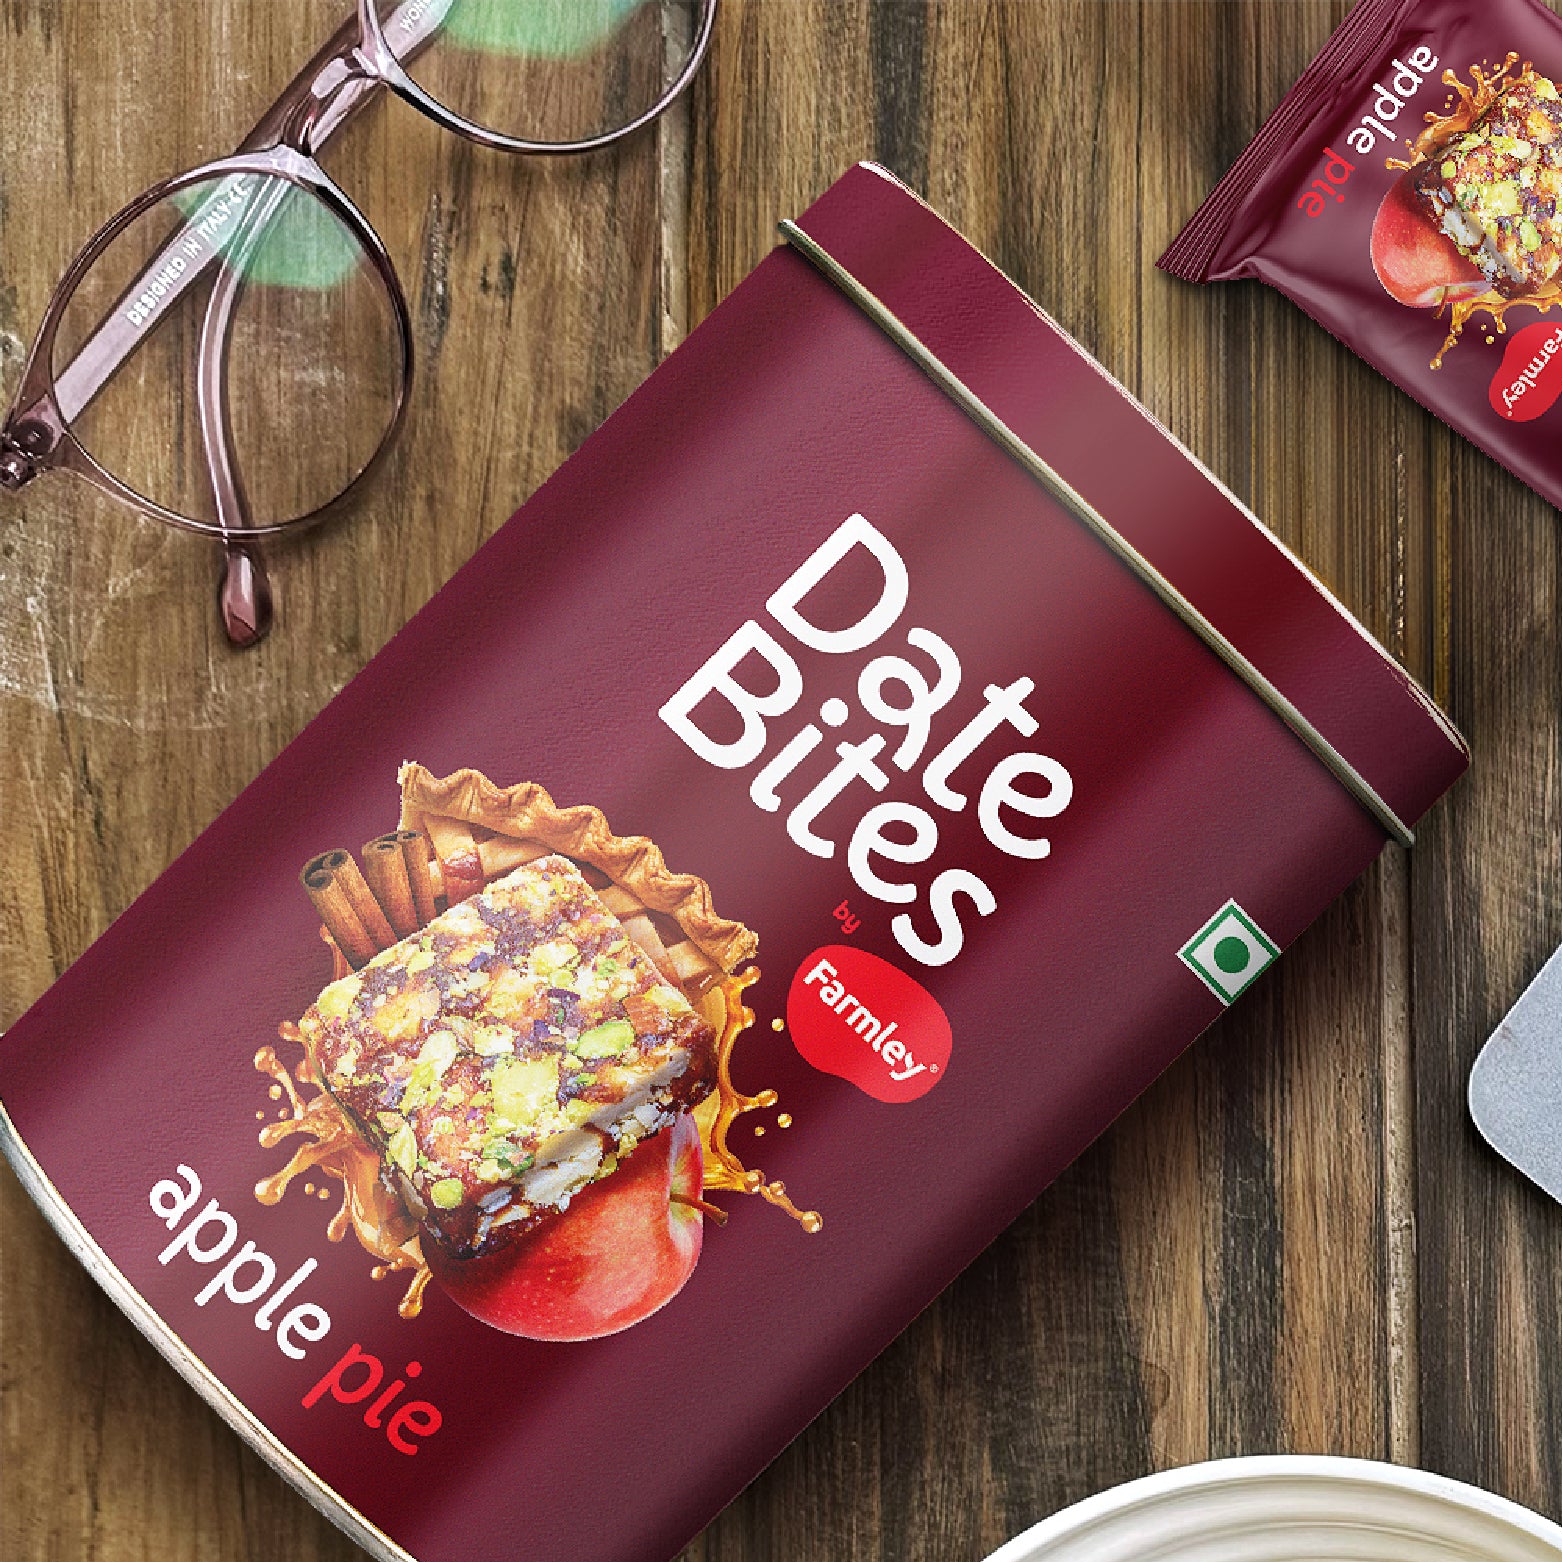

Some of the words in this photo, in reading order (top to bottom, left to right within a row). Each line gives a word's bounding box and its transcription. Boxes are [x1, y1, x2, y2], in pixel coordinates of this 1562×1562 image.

[1346, 45, 1440, 154] apple
[1297, 146, 1356, 218] pie
[126, 256, 187, 326] DESIGNED
[181, 236, 203, 260] IN
[196, 199, 232, 242] ITALY
[764, 513, 1074, 860] Date
[658, 619, 998, 967] Bites
[832, 899, 862, 935] by
[802, 958, 929, 1081] Farmley
[149, 1163, 331, 1360] apple
[301, 1342, 444, 1456] pie
